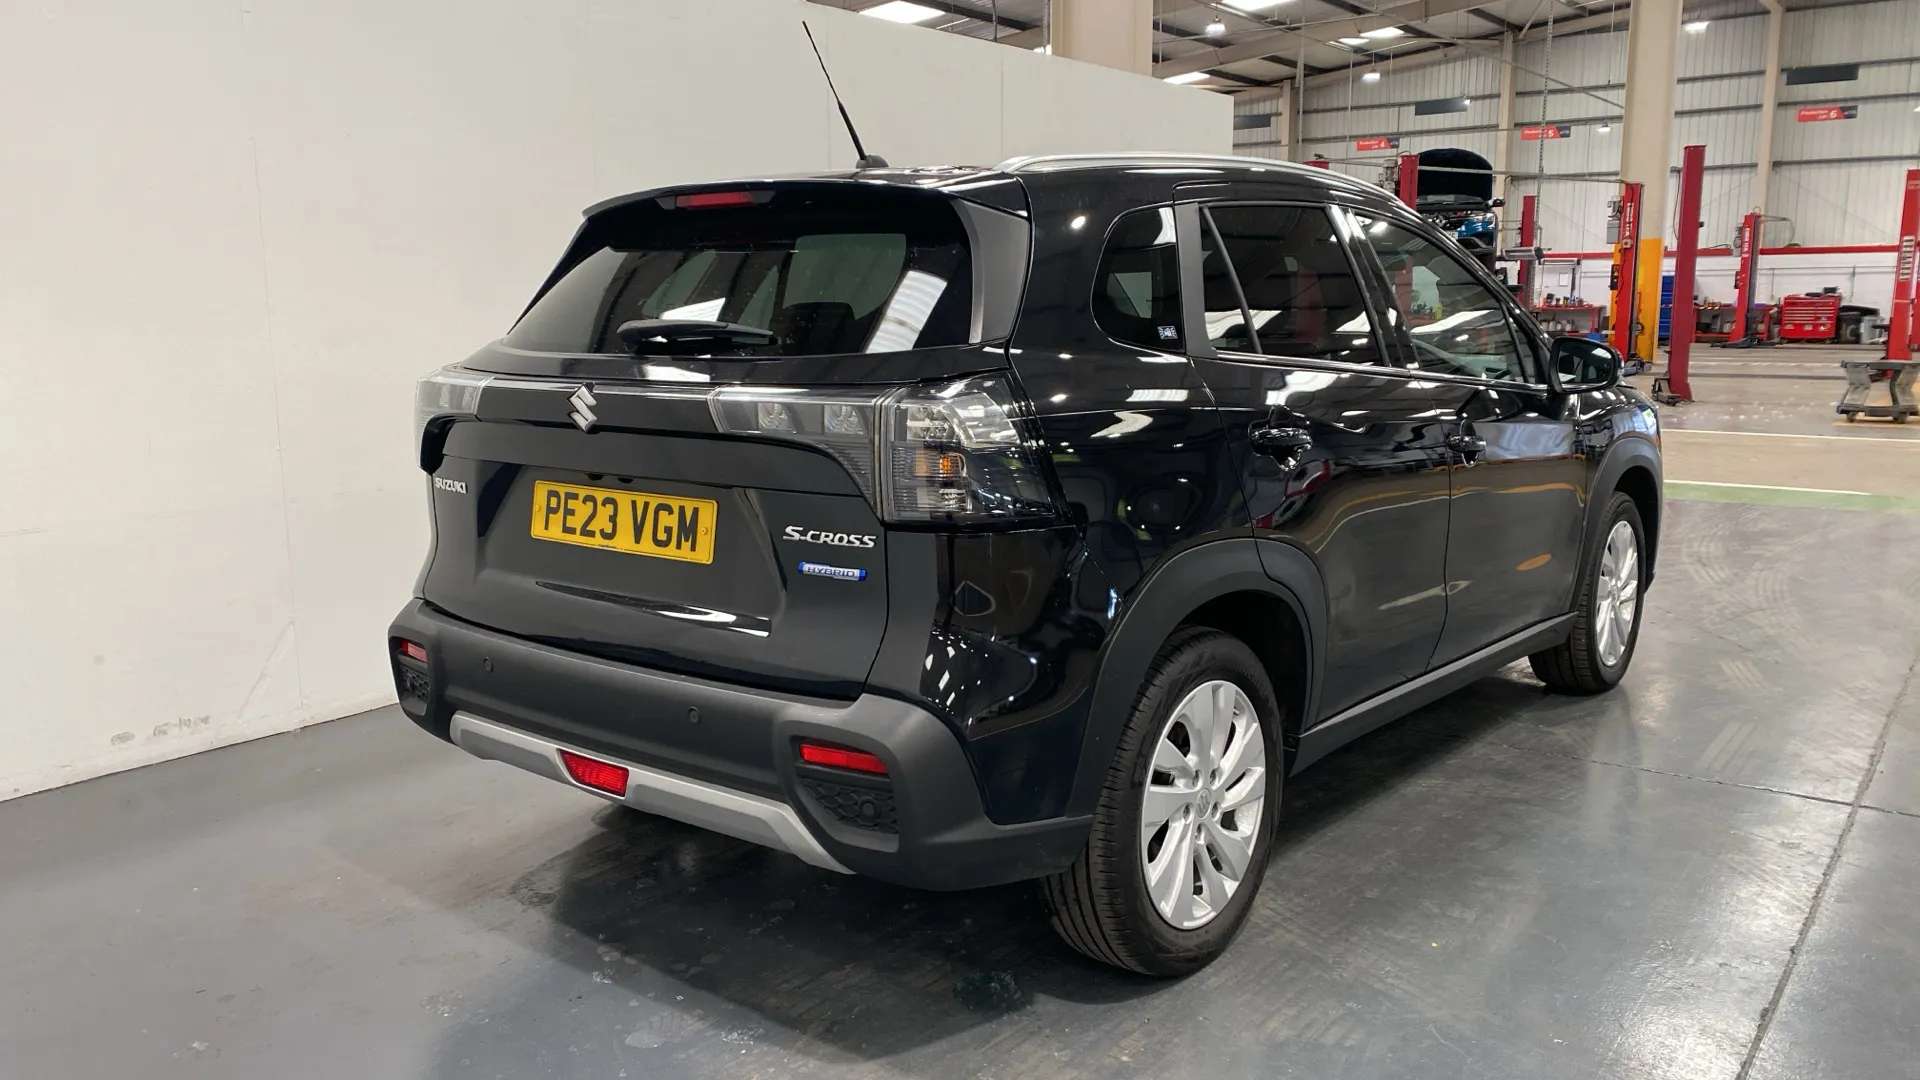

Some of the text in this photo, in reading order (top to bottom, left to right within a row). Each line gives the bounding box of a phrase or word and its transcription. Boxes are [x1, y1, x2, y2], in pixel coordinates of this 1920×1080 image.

[434, 477, 467, 494] SUZUKI
[544, 490, 700, 552] PE23 VGM
[782, 525, 877, 548] S-CROSS
[807, 566, 856, 577] HYBRID
